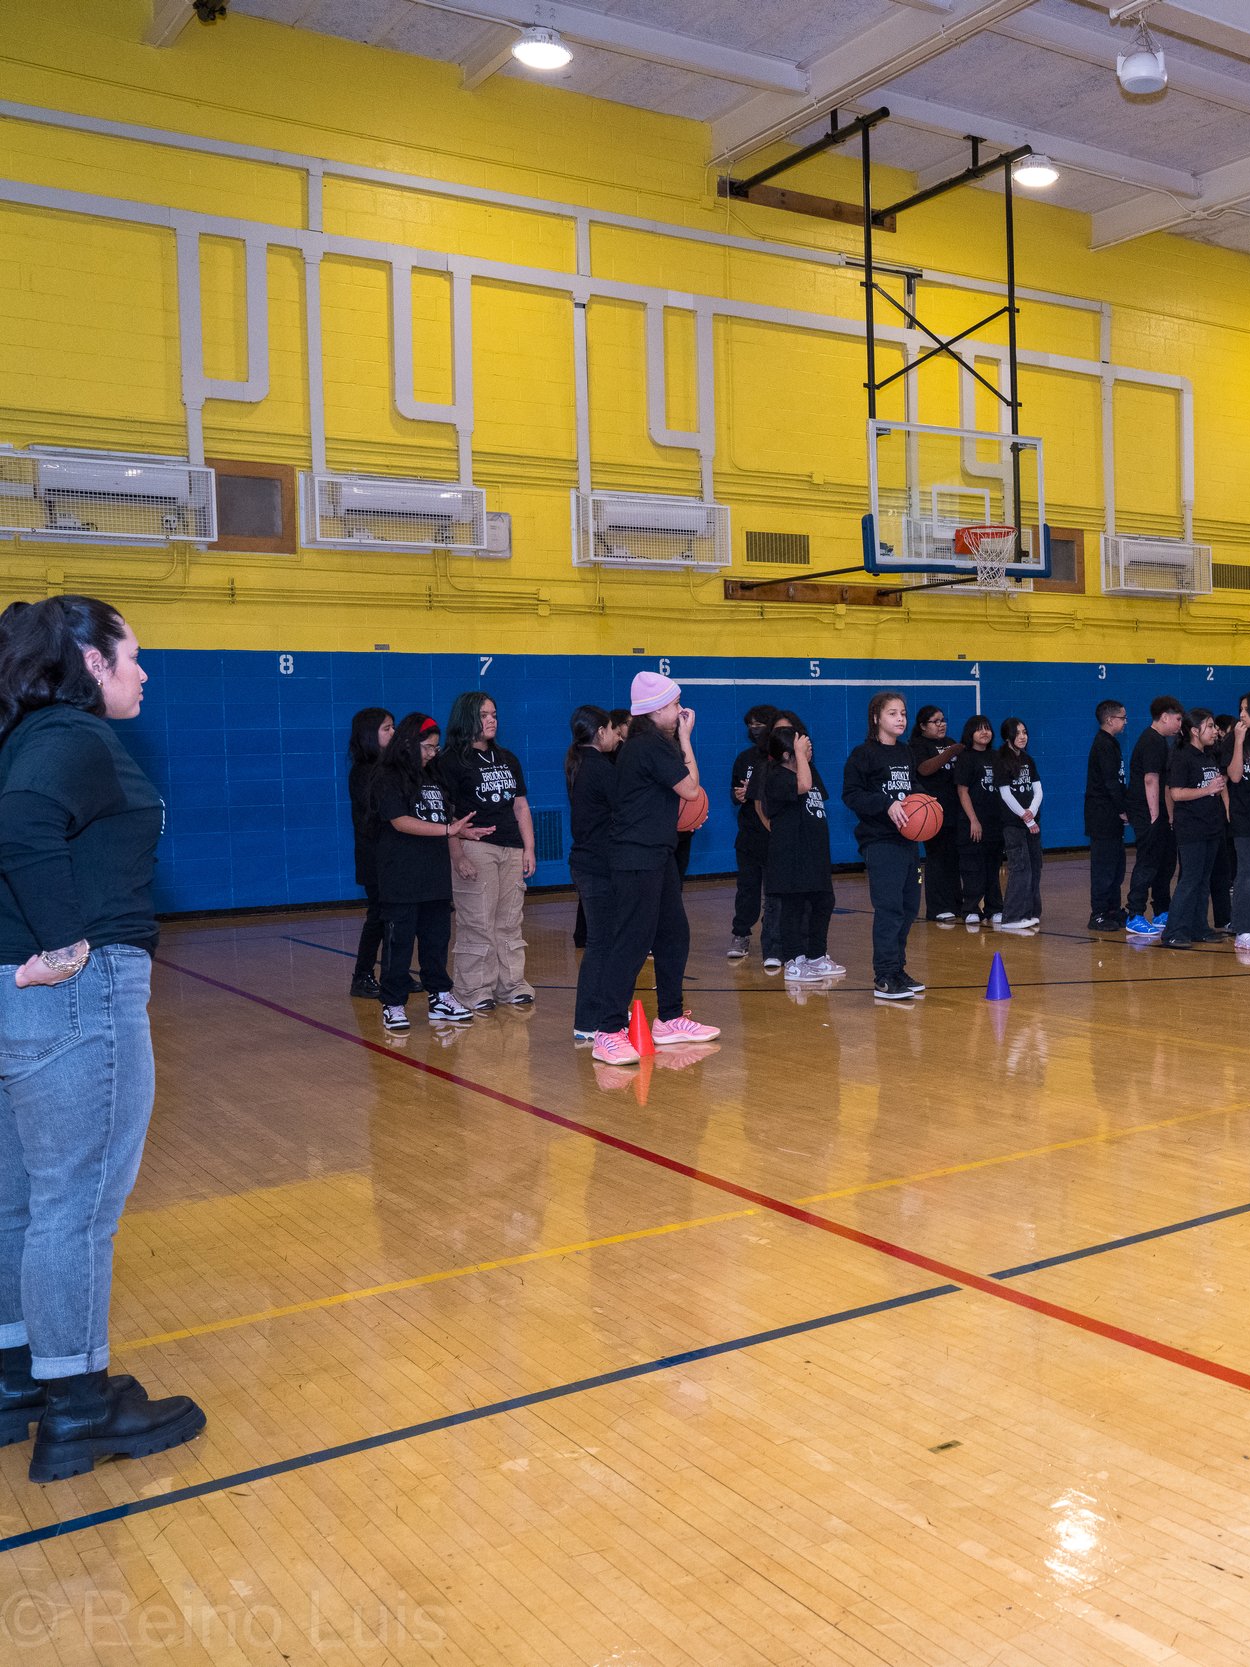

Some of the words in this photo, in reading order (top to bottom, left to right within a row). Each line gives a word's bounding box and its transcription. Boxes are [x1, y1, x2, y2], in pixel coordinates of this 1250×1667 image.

[280, 654, 294, 674] 8
[480, 656, 492, 676] 7
[660, 658, 670, 676] 6
[810, 660, 820, 678] 5
[970, 662, 980, 678] 4
[1098, 664, 1106, 680] 3
[1206, 666, 1214, 681] 2
[482, 770, 512, 782] BROOKLYN
